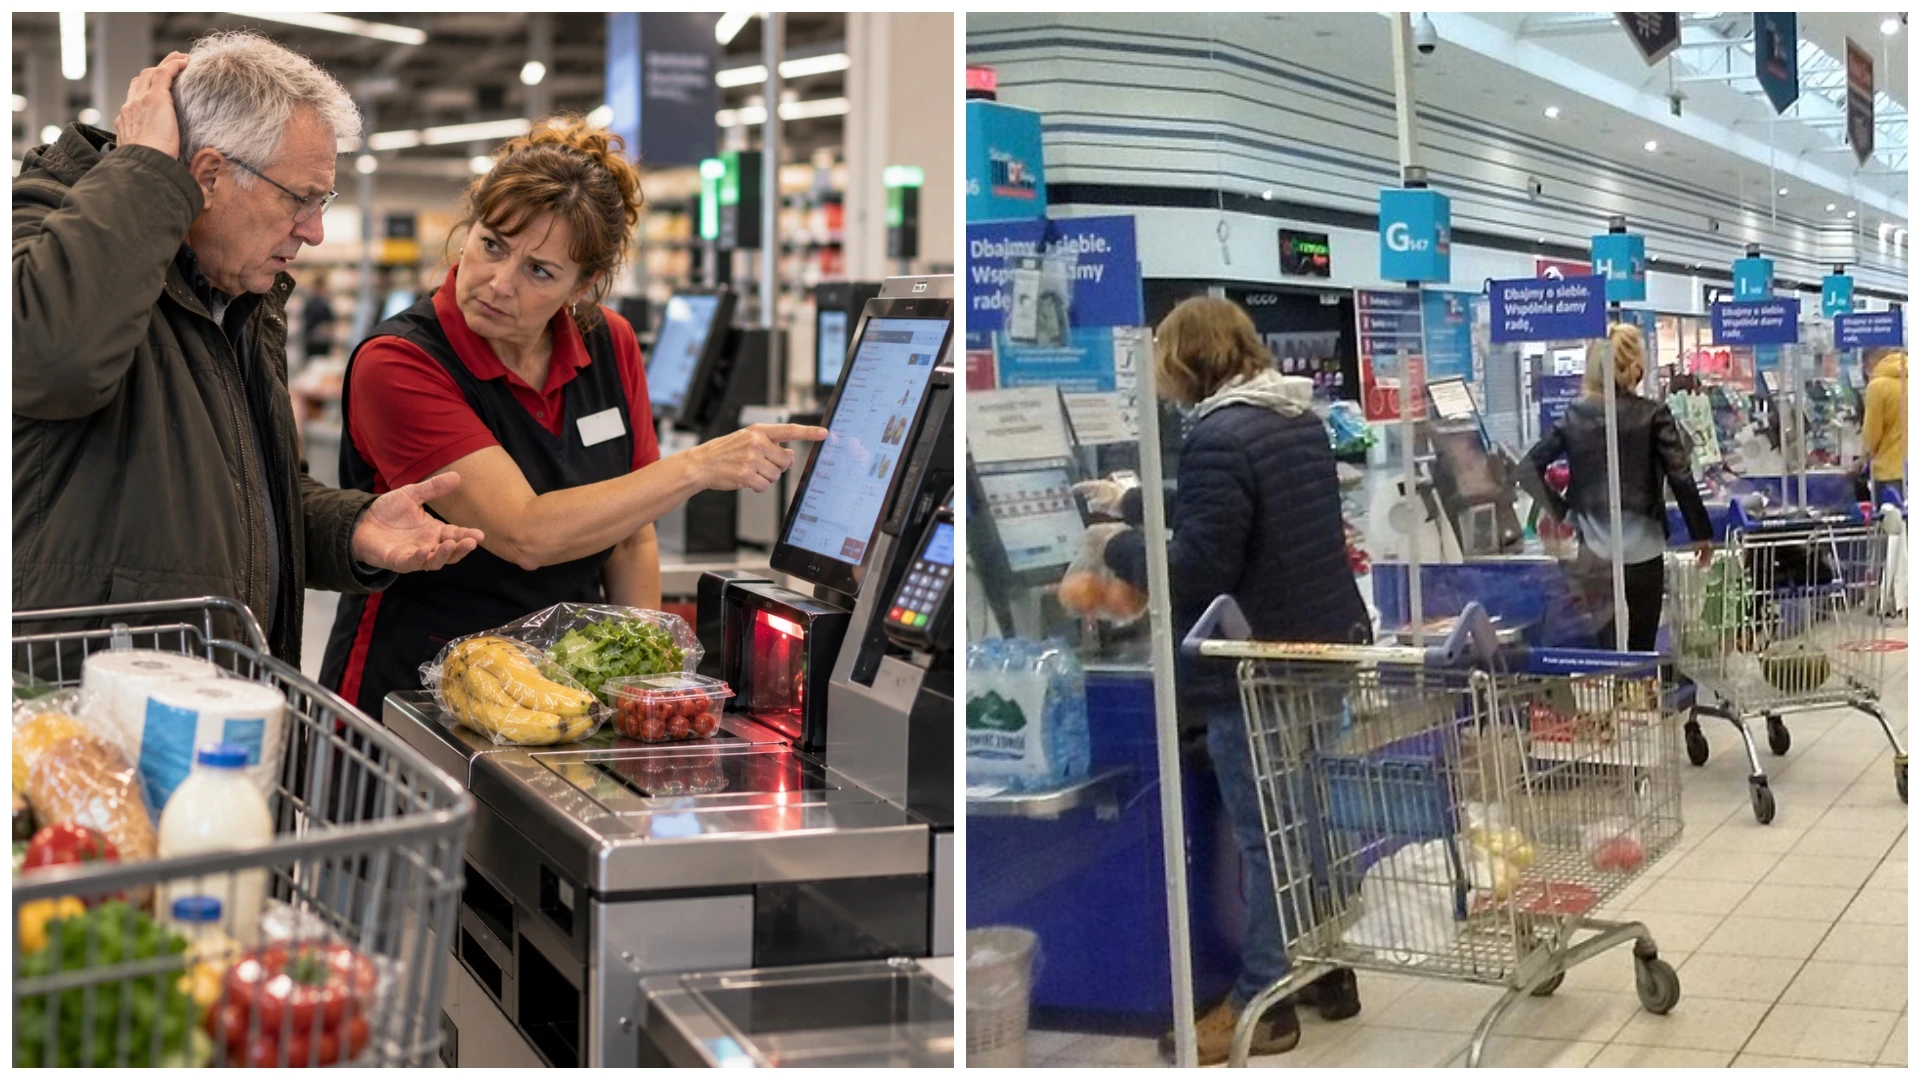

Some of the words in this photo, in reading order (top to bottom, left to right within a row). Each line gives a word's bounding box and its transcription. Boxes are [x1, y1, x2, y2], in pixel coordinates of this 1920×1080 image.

[1504, 288, 1544, 302] Dbajmy
[1546, 288, 1554, 298] o
[1556, 284, 1590, 298] siebie.
[1504, 302, 1553, 316] Wspólnie
[1556, 301, 1586, 315] damy
